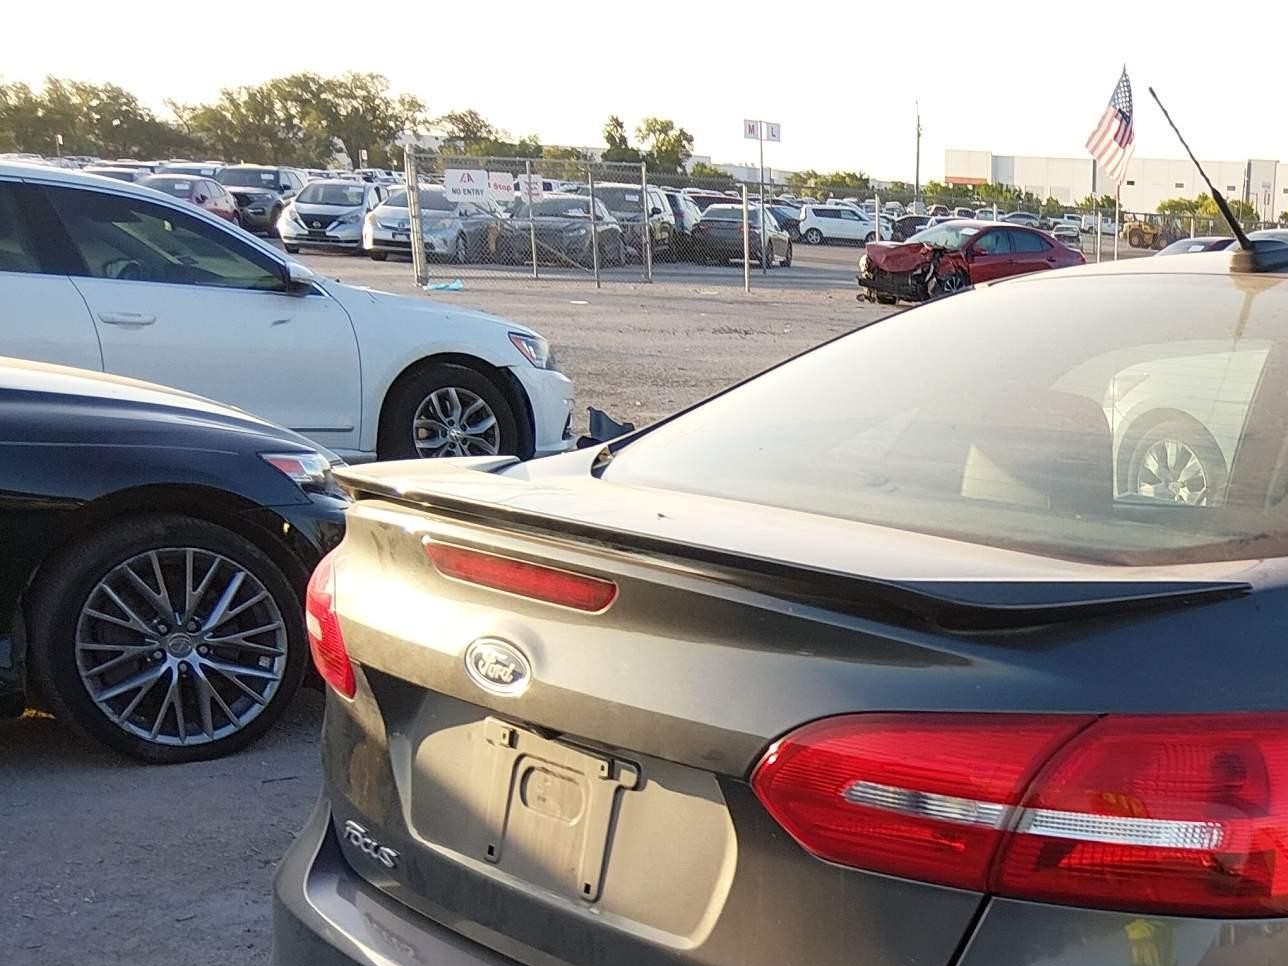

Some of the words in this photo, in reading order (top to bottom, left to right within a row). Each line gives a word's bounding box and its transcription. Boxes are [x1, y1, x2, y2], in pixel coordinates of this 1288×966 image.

[463, 188, 484, 196] ENTRY
[493, 182, 512, 192] Stop
[477, 648, 516, 683] Ford
